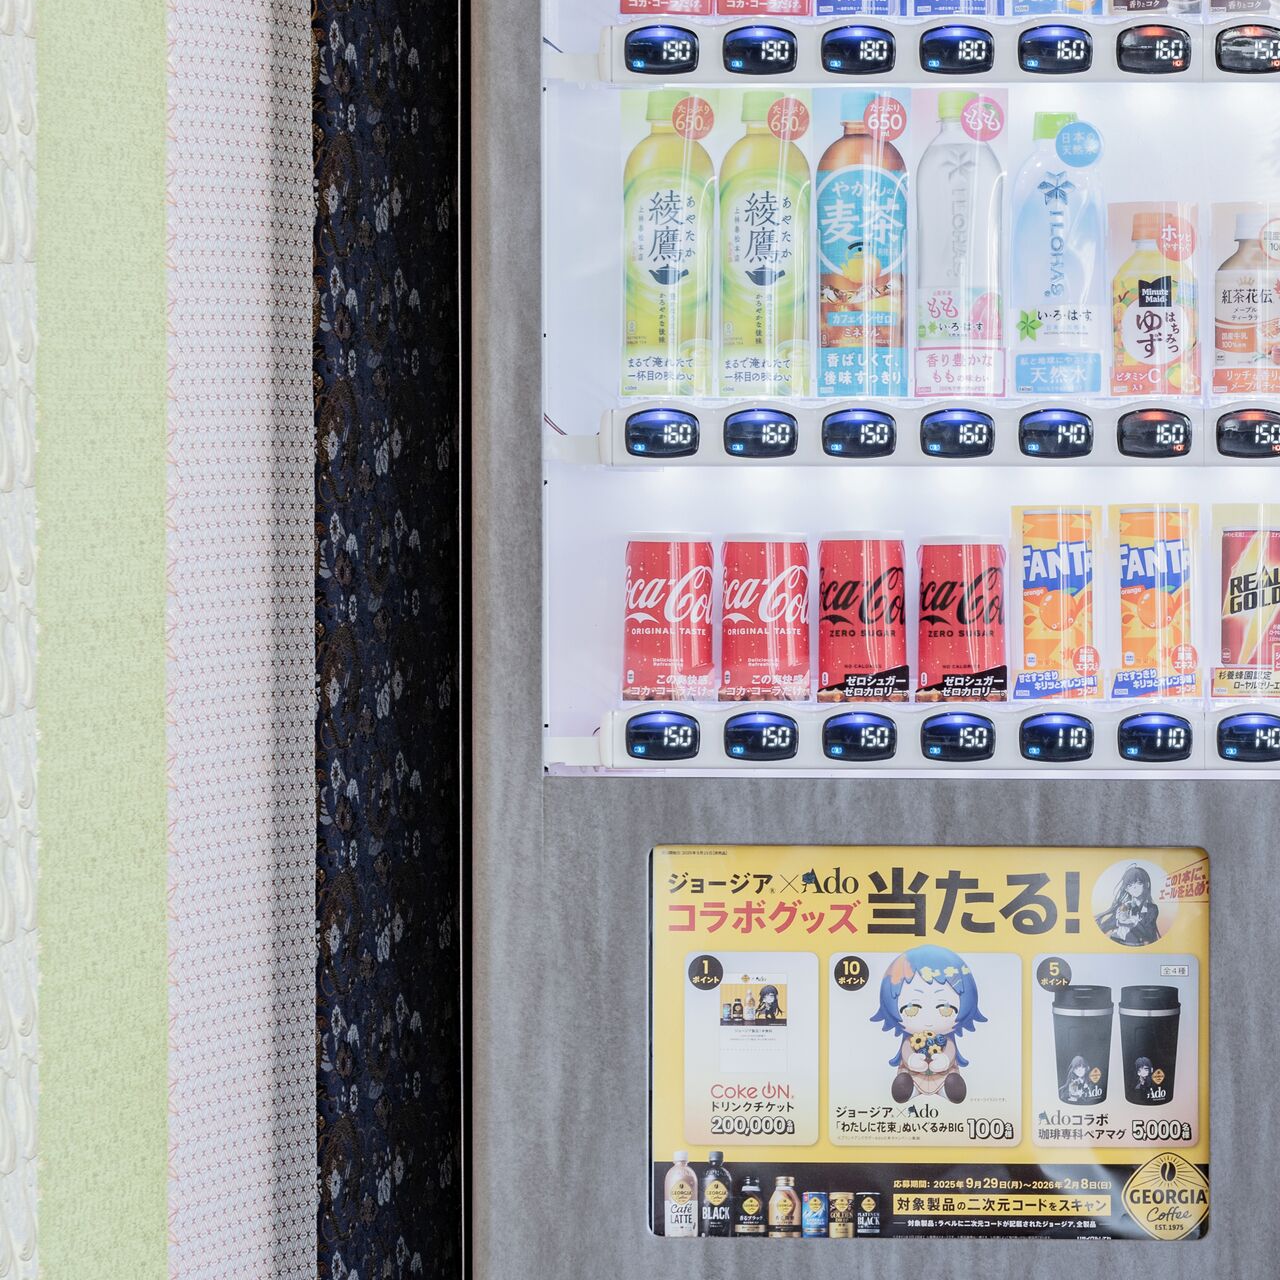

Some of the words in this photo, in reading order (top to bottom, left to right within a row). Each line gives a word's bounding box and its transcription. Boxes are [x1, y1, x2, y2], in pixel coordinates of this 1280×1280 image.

[662, 40, 691, 60] 190
[761, 40, 789, 60] 190
[859, 40, 888, 60] 180
[957, 40, 986, 60] 180
[1056, 40, 1085, 60] 160
[1154, 40, 1183, 60] 160
[867, 114, 903, 130] 650
[648, 190, 684, 262] 綾鷹
[744, 191, 780, 263] 綾鷹
[821, 199, 904, 244] 麦茶
[1222, 289, 1273, 304] 紅茶花伝
[927, 297, 958, 318] もも
[1136, 310, 1163, 358] ゆず
[1165, 311, 1181, 352] はちみつ
[826, 352, 900, 367] 香ばしくて、
[927, 353, 993, 367] 香り豊かな
[824, 370, 901, 385] 後味すっきり
[1030, 366, 1088, 384] 天然水
[1116, 368, 1161, 384] ビタミンC
[663, 423, 692, 444] 160
[761, 423, 790, 444] 160
[860, 423, 889, 444] 150
[958, 423, 987, 444] 160
[1057, 423, 1086, 444] 140
[1156, 423, 1184, 444] 160
[1023, 588, 1044, 597] orange
[1121, 587, 1142, 596] orange
[631, 627, 676, 635] ORIGINAL
[679, 628, 706, 636] TASTE
[727, 627, 770, 635] ORIGINAL
[773, 628, 801, 636] TASTE
[829, 629, 856, 638] ZERO
[860, 629, 896, 638] SUGAR
[928, 629, 954, 638] ZERO
[958, 629, 994, 638] SUGAR
[846, 676, 906, 686] ゼロシュガー
[944, 676, 1004, 686] ゼロシュガー
[844, 686, 908, 697] ゼロカロリー。
[941, 686, 1006, 697] ゼロカロリー。
[662, 728, 692, 748] 150
[761, 728, 791, 748] 150
[860, 728, 889, 748] 150
[958, 728, 987, 748] 150
[1057, 728, 1087, 748] 110
[1155, 728, 1185, 748] 110
[801, 868, 860, 895] Ado
[867, 867, 1081, 937] 当たる!
[668, 899, 862, 935] コラボグッズ
[842, 961, 861, 975] 10
[1048, 962, 1060, 976] 5
[1162, 967, 1187, 976] 全4種
[692, 975, 720, 984] ポイント
[838, 976, 867, 985] ポイント
[1040, 977, 1068, 986] ポイント
[711, 1084, 758, 1099] Coke
[712, 1101, 794, 1112] ドリンクチケット
[907, 1103, 939, 1118] Ado
[711, 1116, 796, 1136] 200,000名様
[1038, 1110, 1109, 1126] Adoコラボ
[967, 1118, 1014, 1140] 100名様
[1038, 1127, 1127, 1140] 珈琲専科ペアマグ
[1132, 1119, 1192, 1141] 5,000名様
[897, 1197, 1107, 1212] 対象製品の二次元コードをスキャン
[1129, 1188, 1207, 1205] GEORGIA
[670, 1214, 693, 1224] LATTE
[702, 1207, 730, 1220] BLACK
[1145, 1207, 1192, 1223] Coffee
